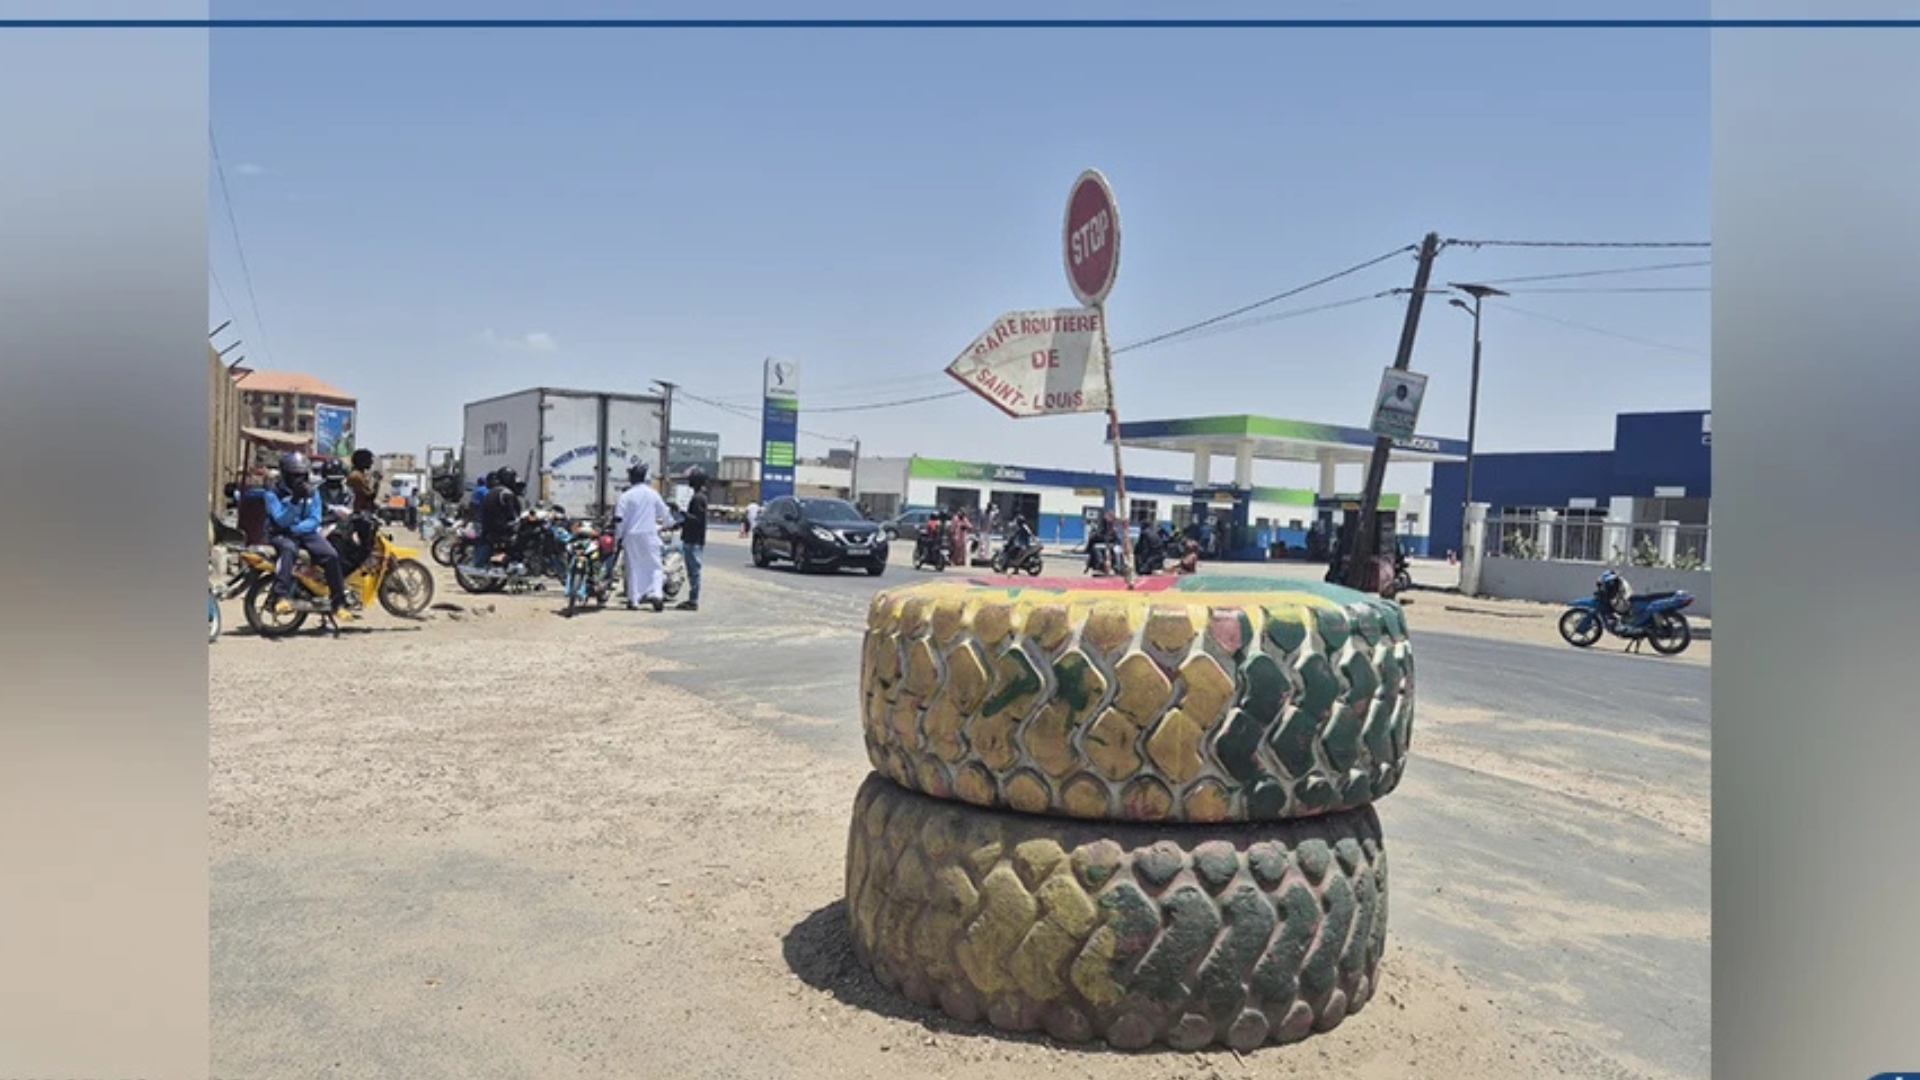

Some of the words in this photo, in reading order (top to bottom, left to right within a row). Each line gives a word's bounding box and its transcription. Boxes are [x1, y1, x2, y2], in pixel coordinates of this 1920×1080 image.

[1071, 208, 1109, 265] STOP
[1021, 314, 1099, 335] ROUTIERE
[1031, 349, 1060, 369] DE
